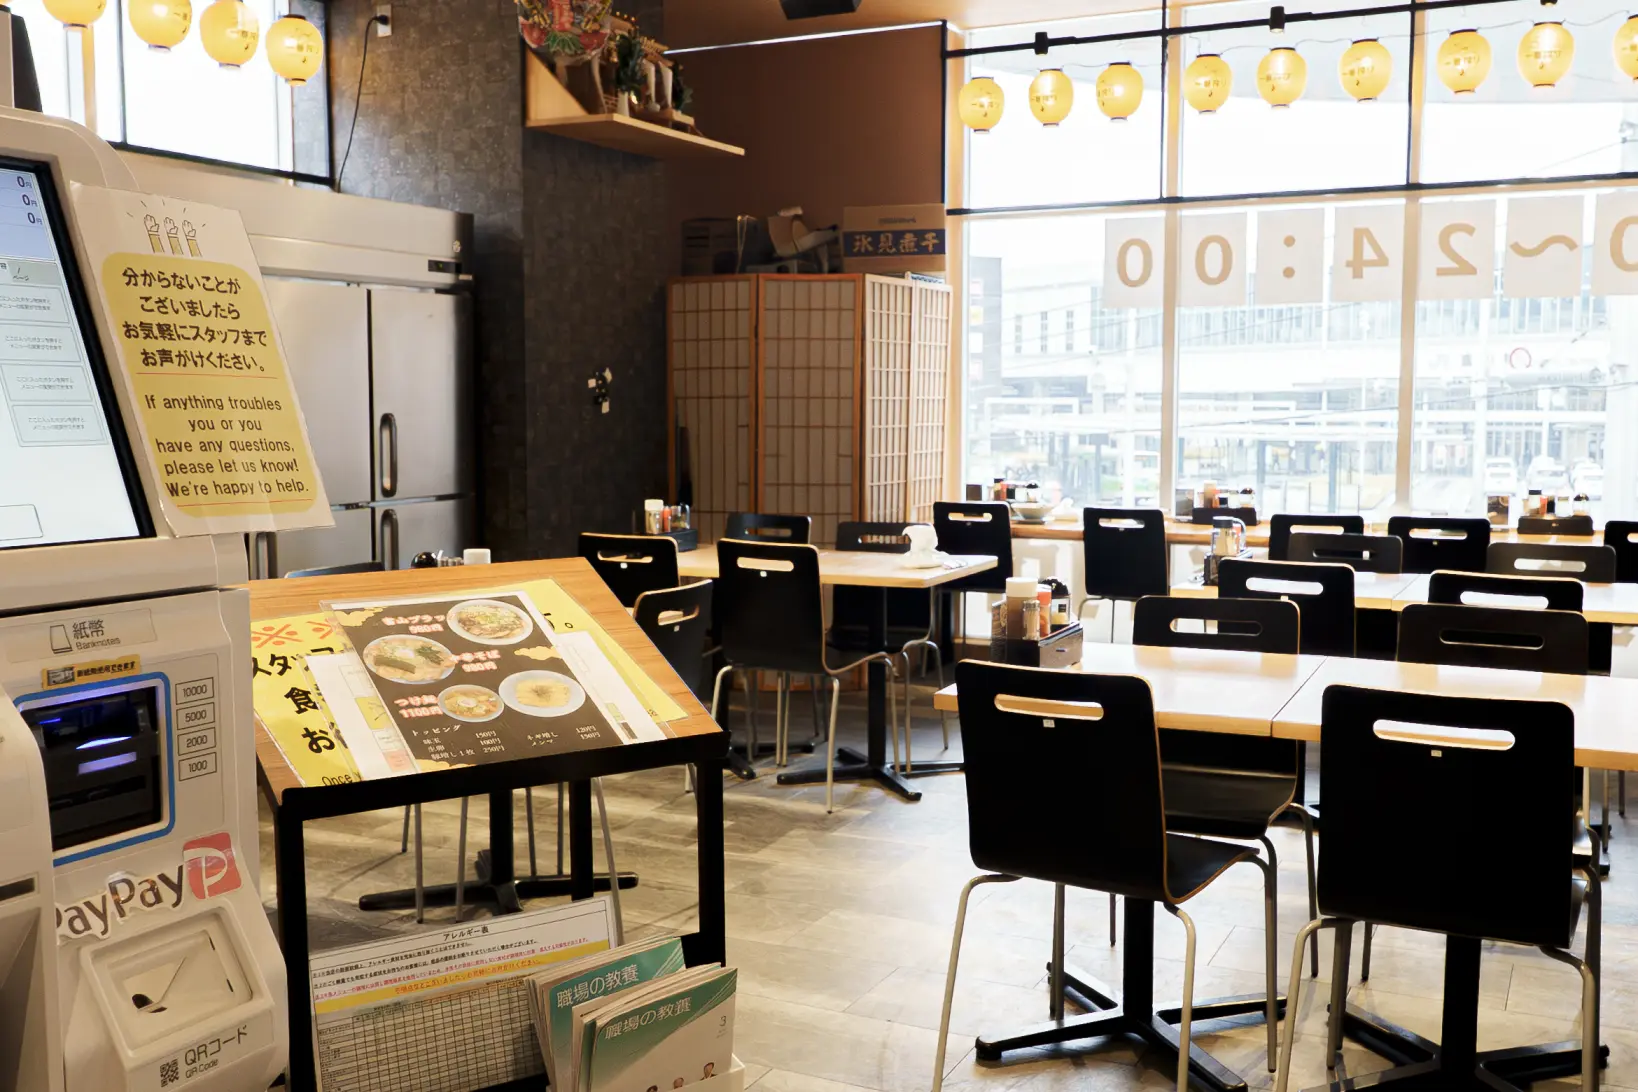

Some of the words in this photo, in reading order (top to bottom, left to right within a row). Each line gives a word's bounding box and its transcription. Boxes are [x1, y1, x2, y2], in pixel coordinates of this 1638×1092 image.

[122, 267, 241, 295] 分からないことが
[139, 296, 241, 321] ございましたら
[122, 321, 267, 347] お気軽にスタッフまで
[141, 350, 266, 372] お声がけください。
[145, 395, 156, 409] If
[163, 395, 224, 411] anything
[228, 397, 282, 411] troubles
[188, 419, 215, 432] you
[221, 419, 234, 432] or
[238, 419, 262, 432] you
[156, 439, 193, 453] have
[199, 441, 223, 454] any
[164, 459, 214, 476] please
[218, 458, 238, 474] let
[243, 461, 257, 473] us
[261, 458, 299, 472] know!
[165, 480, 208, 497] We're
[213, 479, 255, 497] happy
[259, 479, 272, 494] to
[277, 478, 310, 495] help.
[72, 619, 105, 640] 紙幣
[76, 637, 121, 650] Banknotes
[183, 684, 208, 698] 10000
[185, 710, 207, 722] 5000
[186, 735, 208, 748] 2000
[188, 760, 208, 773] 1000
[443, 926, 489, 941] アレルギー表
[556, 964, 640, 1009] 職場の教養
[605, 997, 692, 1040] 職場の教養
[719, 1015, 728, 1027] 3
[184, 1025, 248, 1066] QRコード
[198, 1058, 219, 1075] Code
